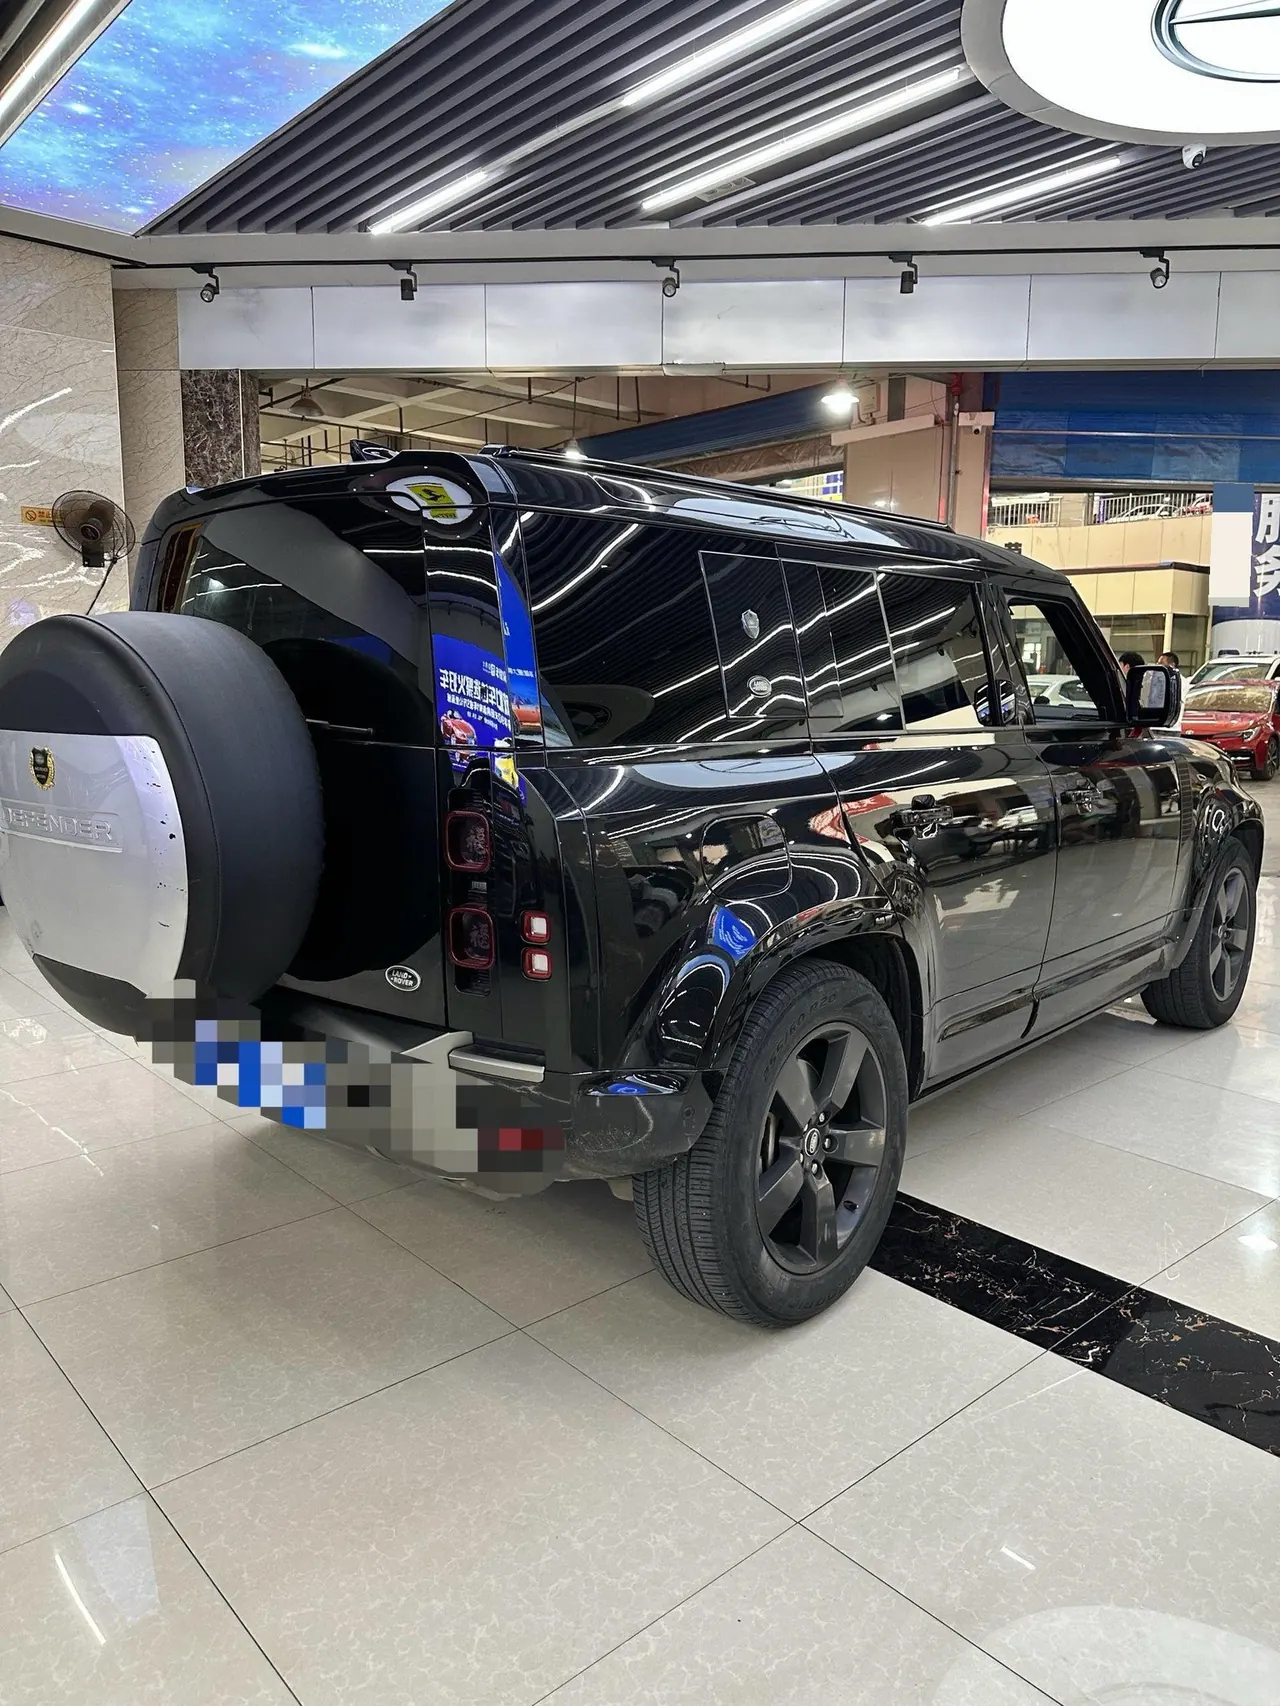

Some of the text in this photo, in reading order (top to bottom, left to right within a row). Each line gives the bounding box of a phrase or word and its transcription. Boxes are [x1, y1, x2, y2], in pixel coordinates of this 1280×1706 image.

[0, 806, 113, 840] DEFENDER
[392, 970, 408, 979] LAND
[393, 977, 413, 986] ROVER
